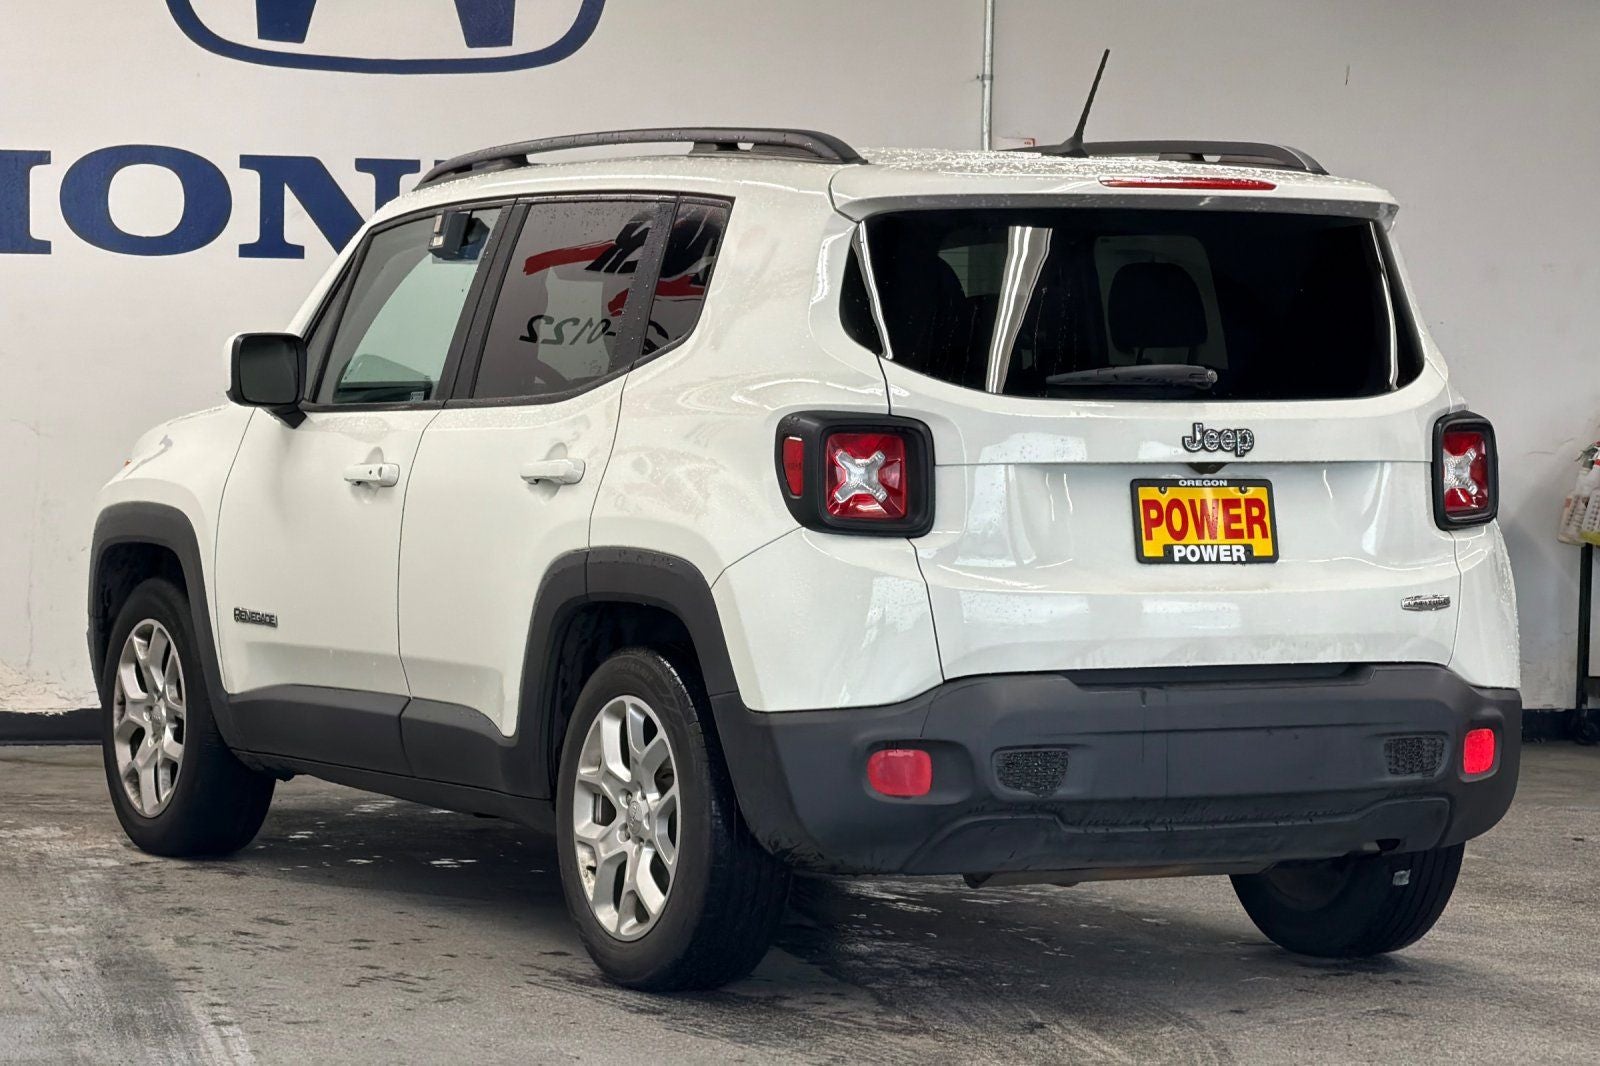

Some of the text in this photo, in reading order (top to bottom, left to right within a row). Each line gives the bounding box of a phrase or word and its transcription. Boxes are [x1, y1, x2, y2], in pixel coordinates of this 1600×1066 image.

[1182, 423, 1255, 457] Jeep
[1178, 479, 1228, 487] OREGON
[1141, 498, 1269, 541] POWER
[1173, 545, 1246, 562] POWER
[233, 607, 278, 628] RENEGADE
